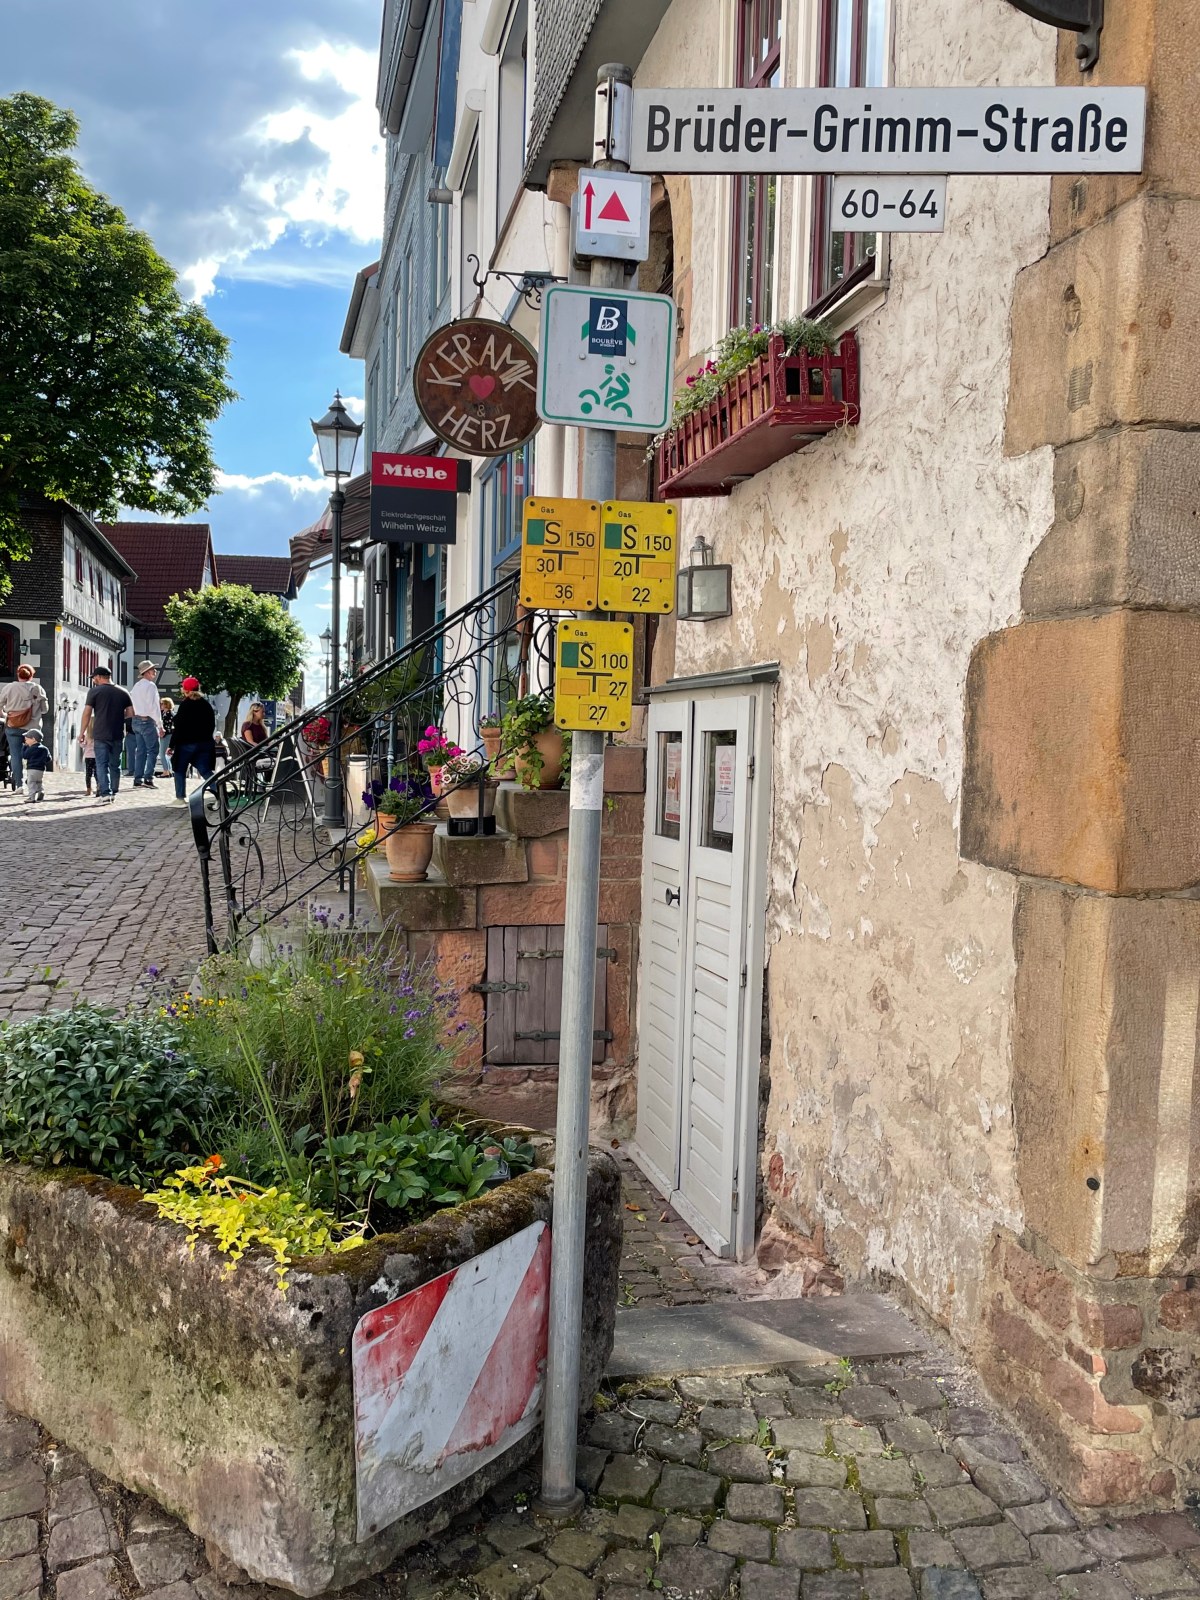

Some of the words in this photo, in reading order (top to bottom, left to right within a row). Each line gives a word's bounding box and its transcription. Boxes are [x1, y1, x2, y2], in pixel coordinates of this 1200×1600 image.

[645, 102, 1130, 154] Brüder-Grimm-Straße
[840, 188, 939, 219] 60-64
[596, 305, 621, 332] B
[426, 333, 537, 393] KERAMIK
[476, 404, 486, 418] &
[438, 405, 519, 450] HERZ
[382, 463, 448, 480] Miele
[381, 510, 447, 521] Elektrofachgeschäft
[540, 506, 555, 514] Gas
[617, 510, 632, 518] Gas
[381, 521, 415, 531] Wilhelm
[416, 523, 447, 533] Weitzel
[545, 521, 561, 545] S
[568, 531, 595, 548] 150
[623, 524, 638, 550] S
[644, 535, 672, 552] 150
[574, 629, 588, 637] Gas
[580, 642, 594, 668] S
[601, 653, 628, 670] 100
